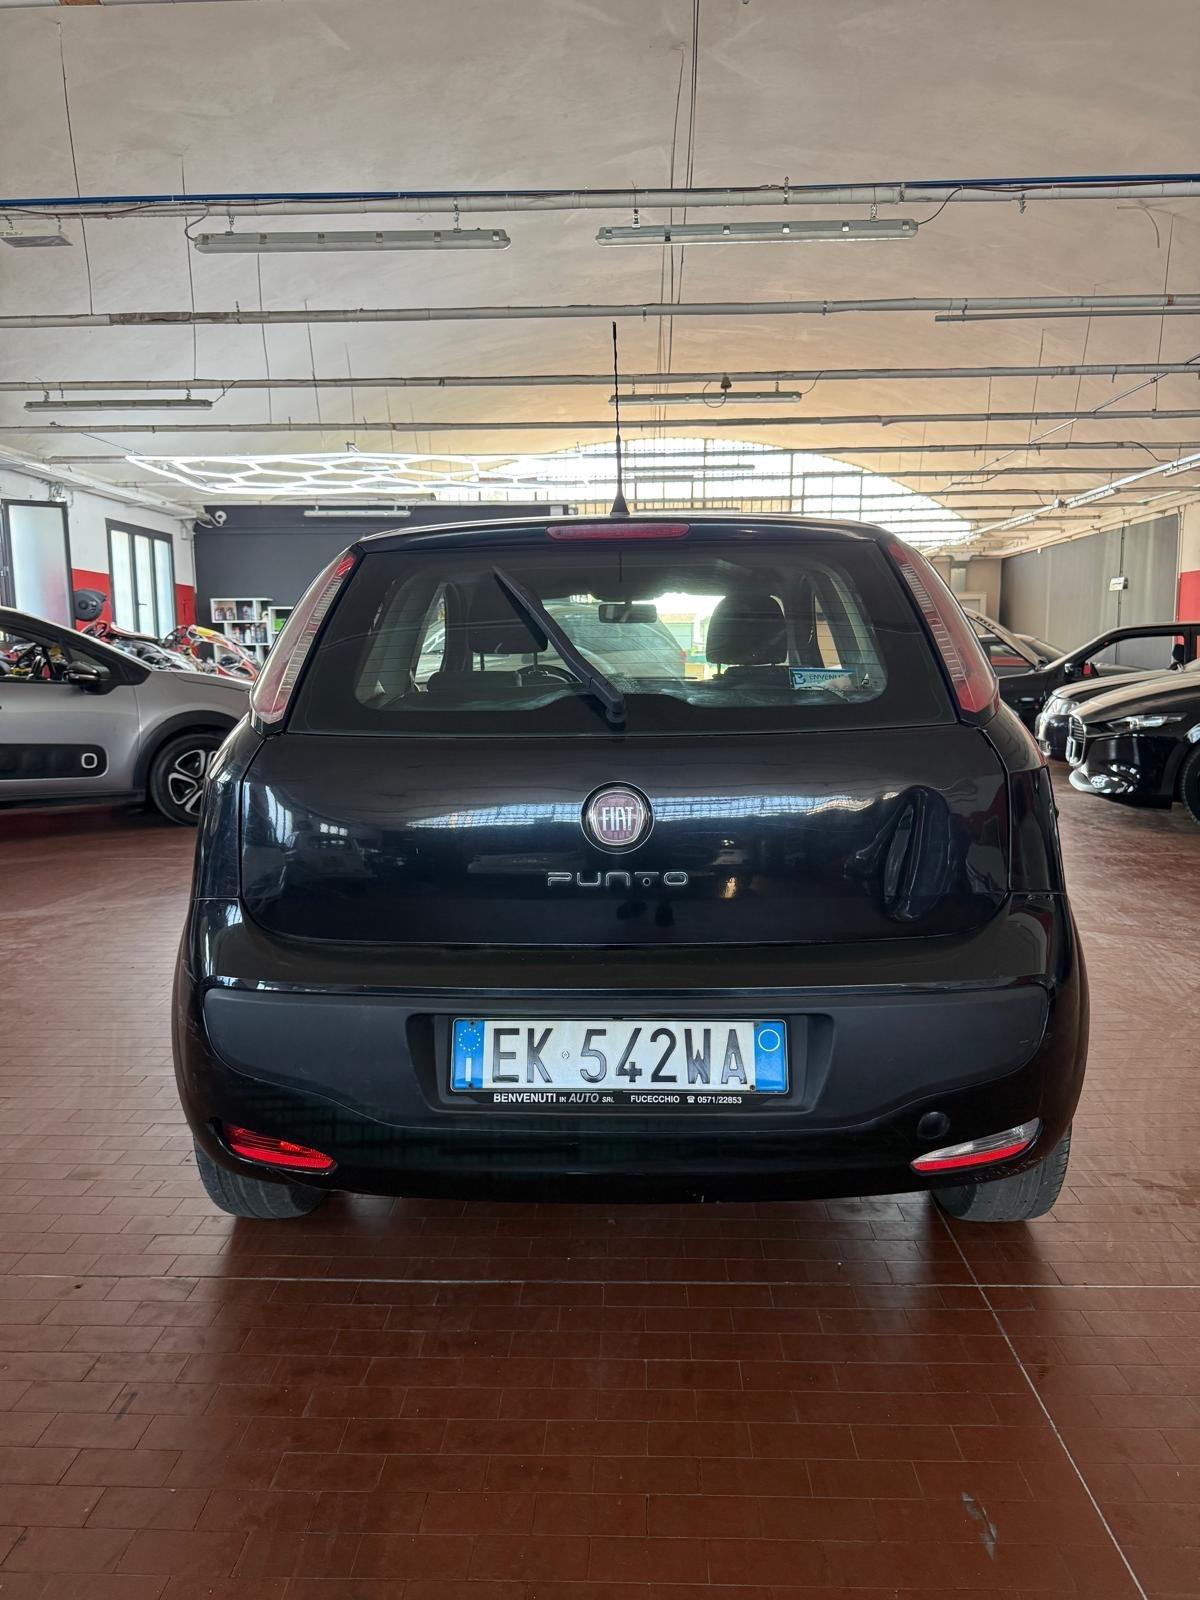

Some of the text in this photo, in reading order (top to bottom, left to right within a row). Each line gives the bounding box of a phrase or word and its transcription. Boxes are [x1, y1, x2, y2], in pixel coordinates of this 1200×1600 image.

[601, 806, 633, 831] FIAT
[547, 871, 688, 887] PUNTO
[492, 1027, 748, 1084] EK 542WA
[493, 1092, 556, 1103] BENVENUTI
[568, 1093, 600, 1103] AUTO
[630, 1095, 742, 1104] FUCECCHIO 0571/22853
